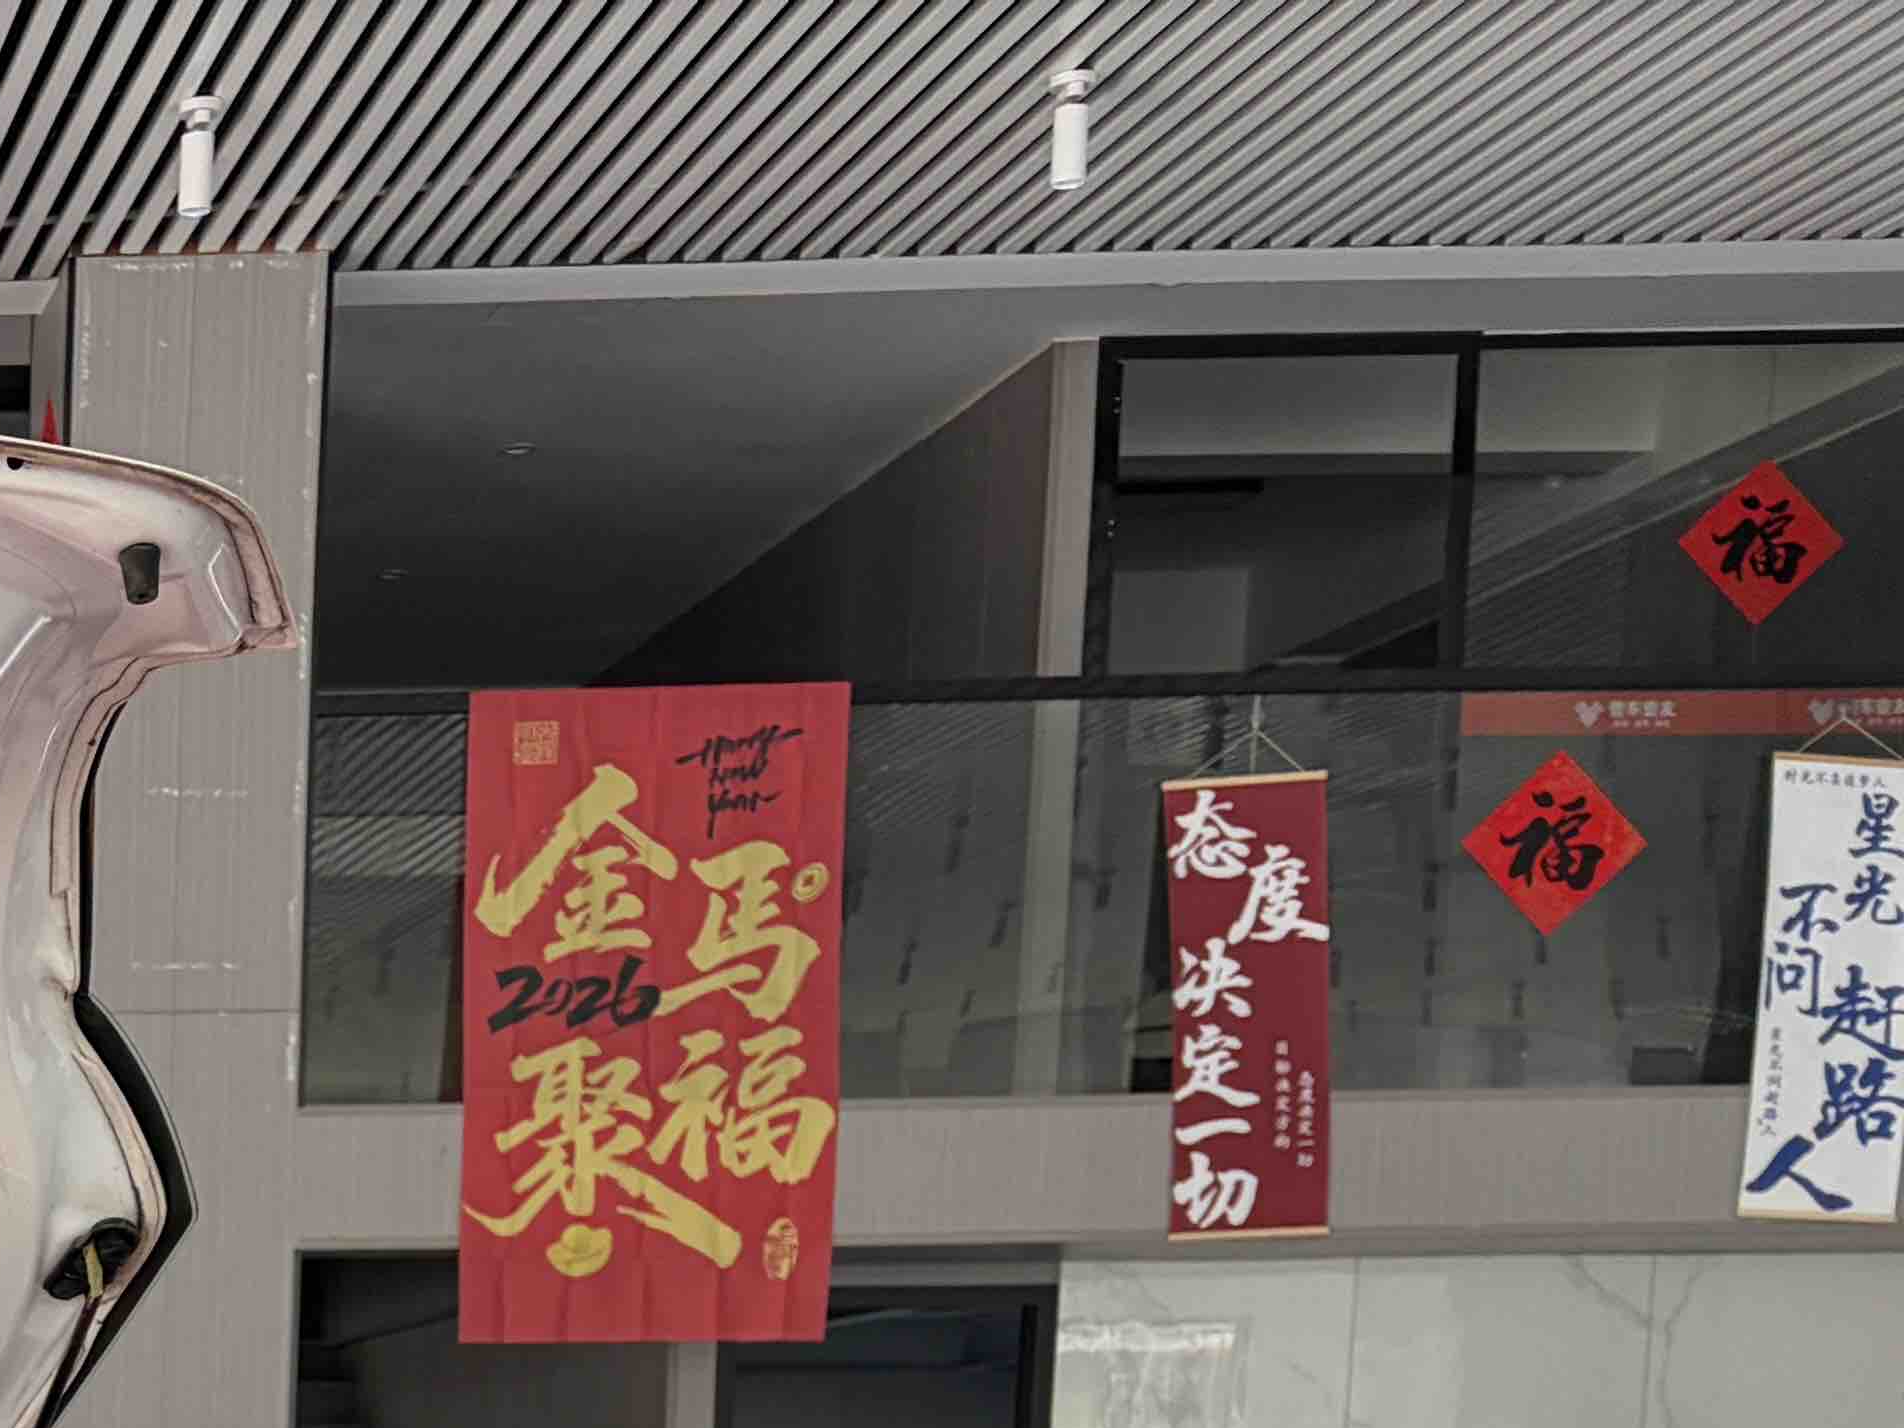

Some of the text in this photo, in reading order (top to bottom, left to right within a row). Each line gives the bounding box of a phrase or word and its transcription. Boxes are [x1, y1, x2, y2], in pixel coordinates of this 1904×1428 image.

[1712, 496, 1807, 584] 福
[1498, 791, 1605, 890] 福
[488, 956, 660, 1033] 2026
